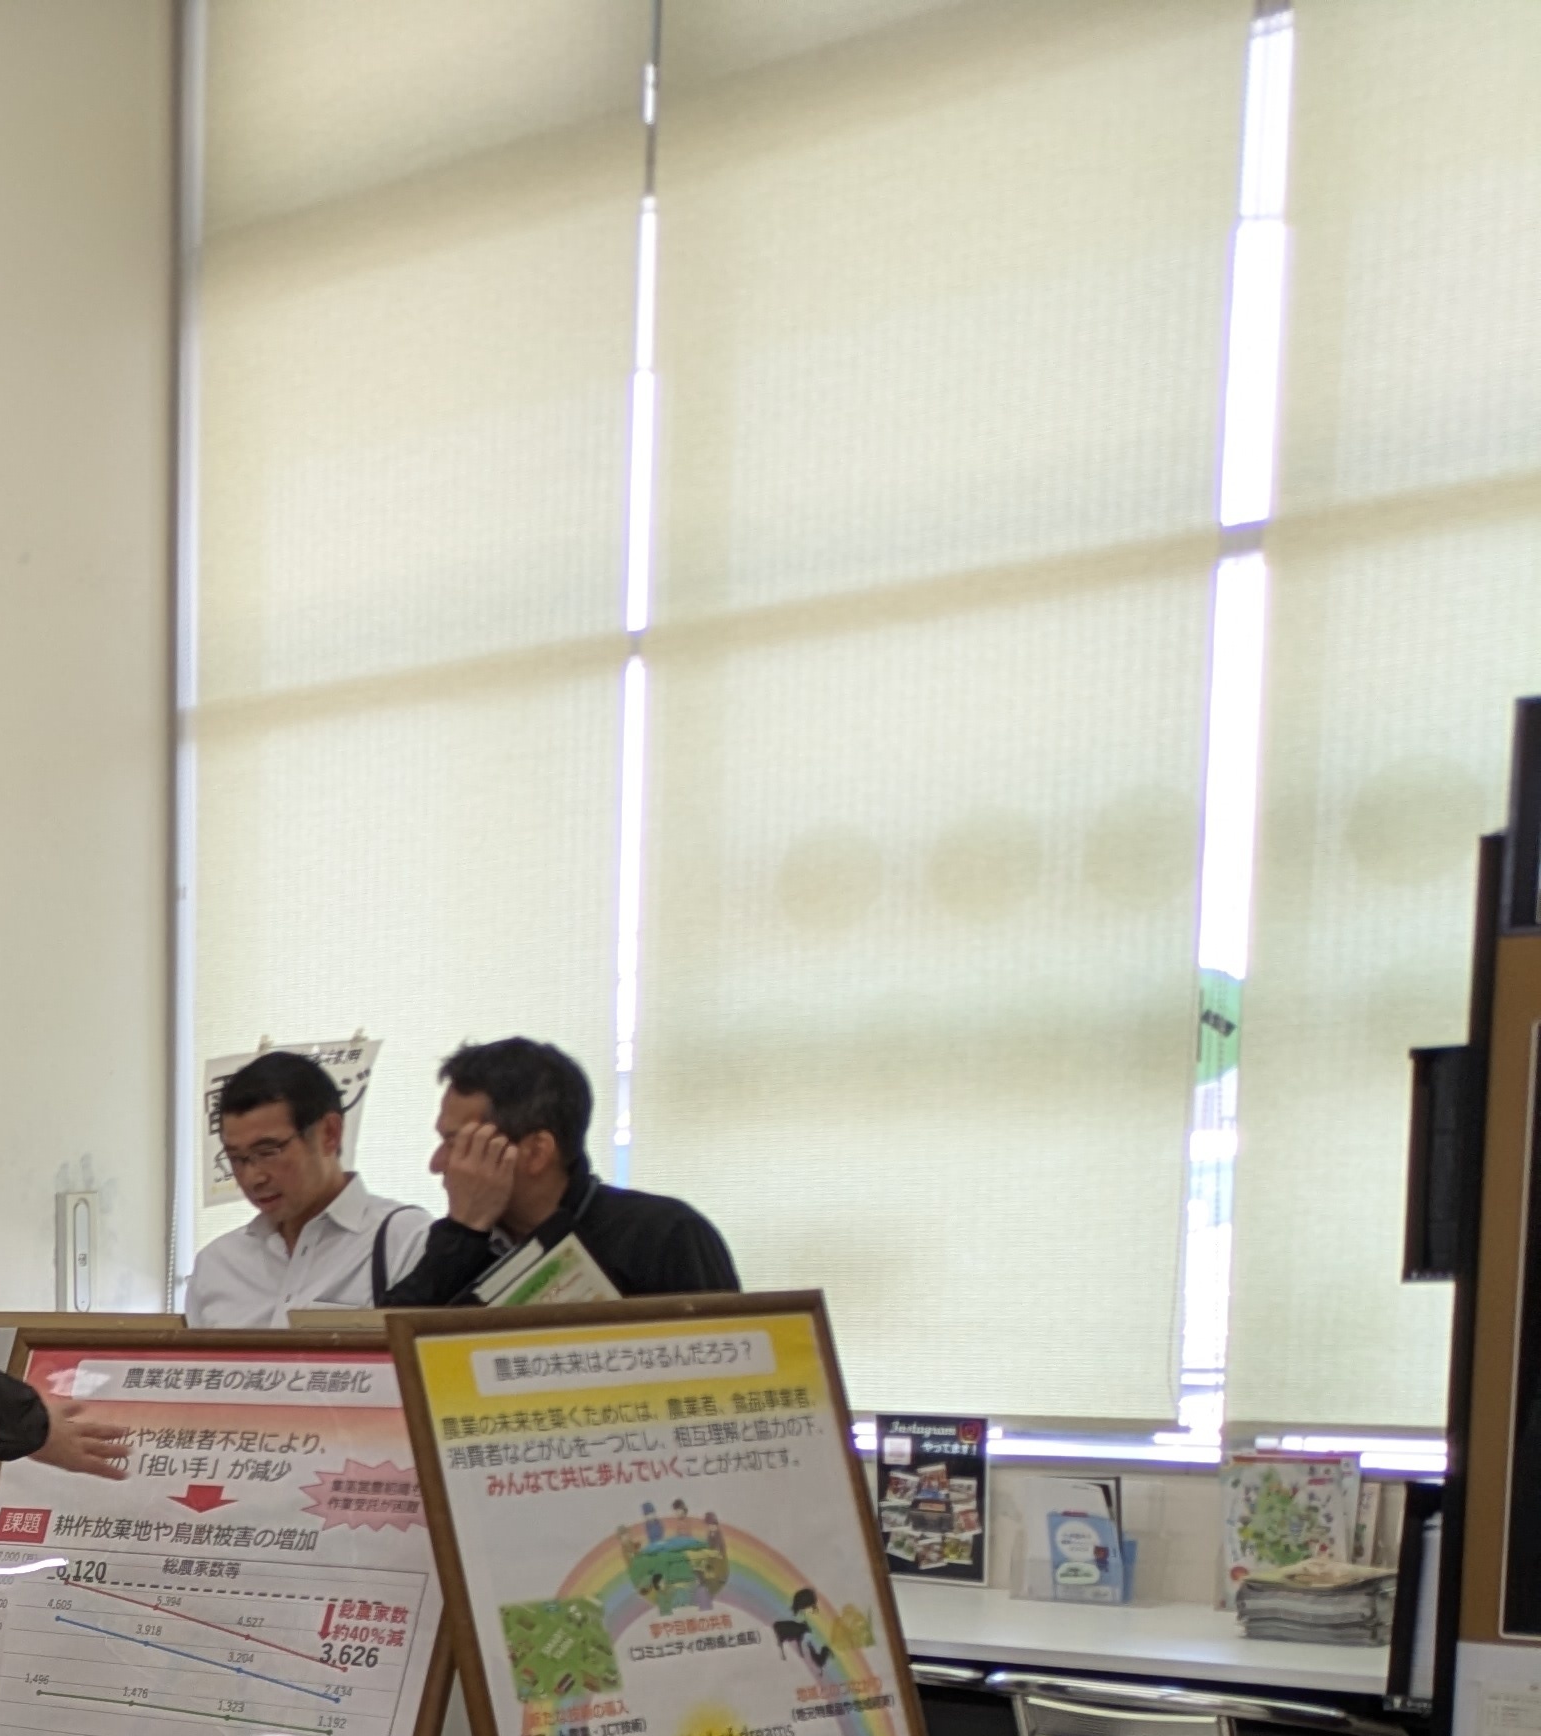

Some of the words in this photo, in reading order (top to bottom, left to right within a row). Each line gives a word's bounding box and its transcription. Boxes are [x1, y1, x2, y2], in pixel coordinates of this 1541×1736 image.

[122, 1367, 374, 1395] 農業従事者の減少と高齢化
[1, 1512, 43, 1534] 課題
[53, 1514, 320, 1552] 耕作放棄地や鳥獣被害の増加
[332, 1625, 406, 1648] 約40%減
[319, 1642, 379, 1669] 3,626
